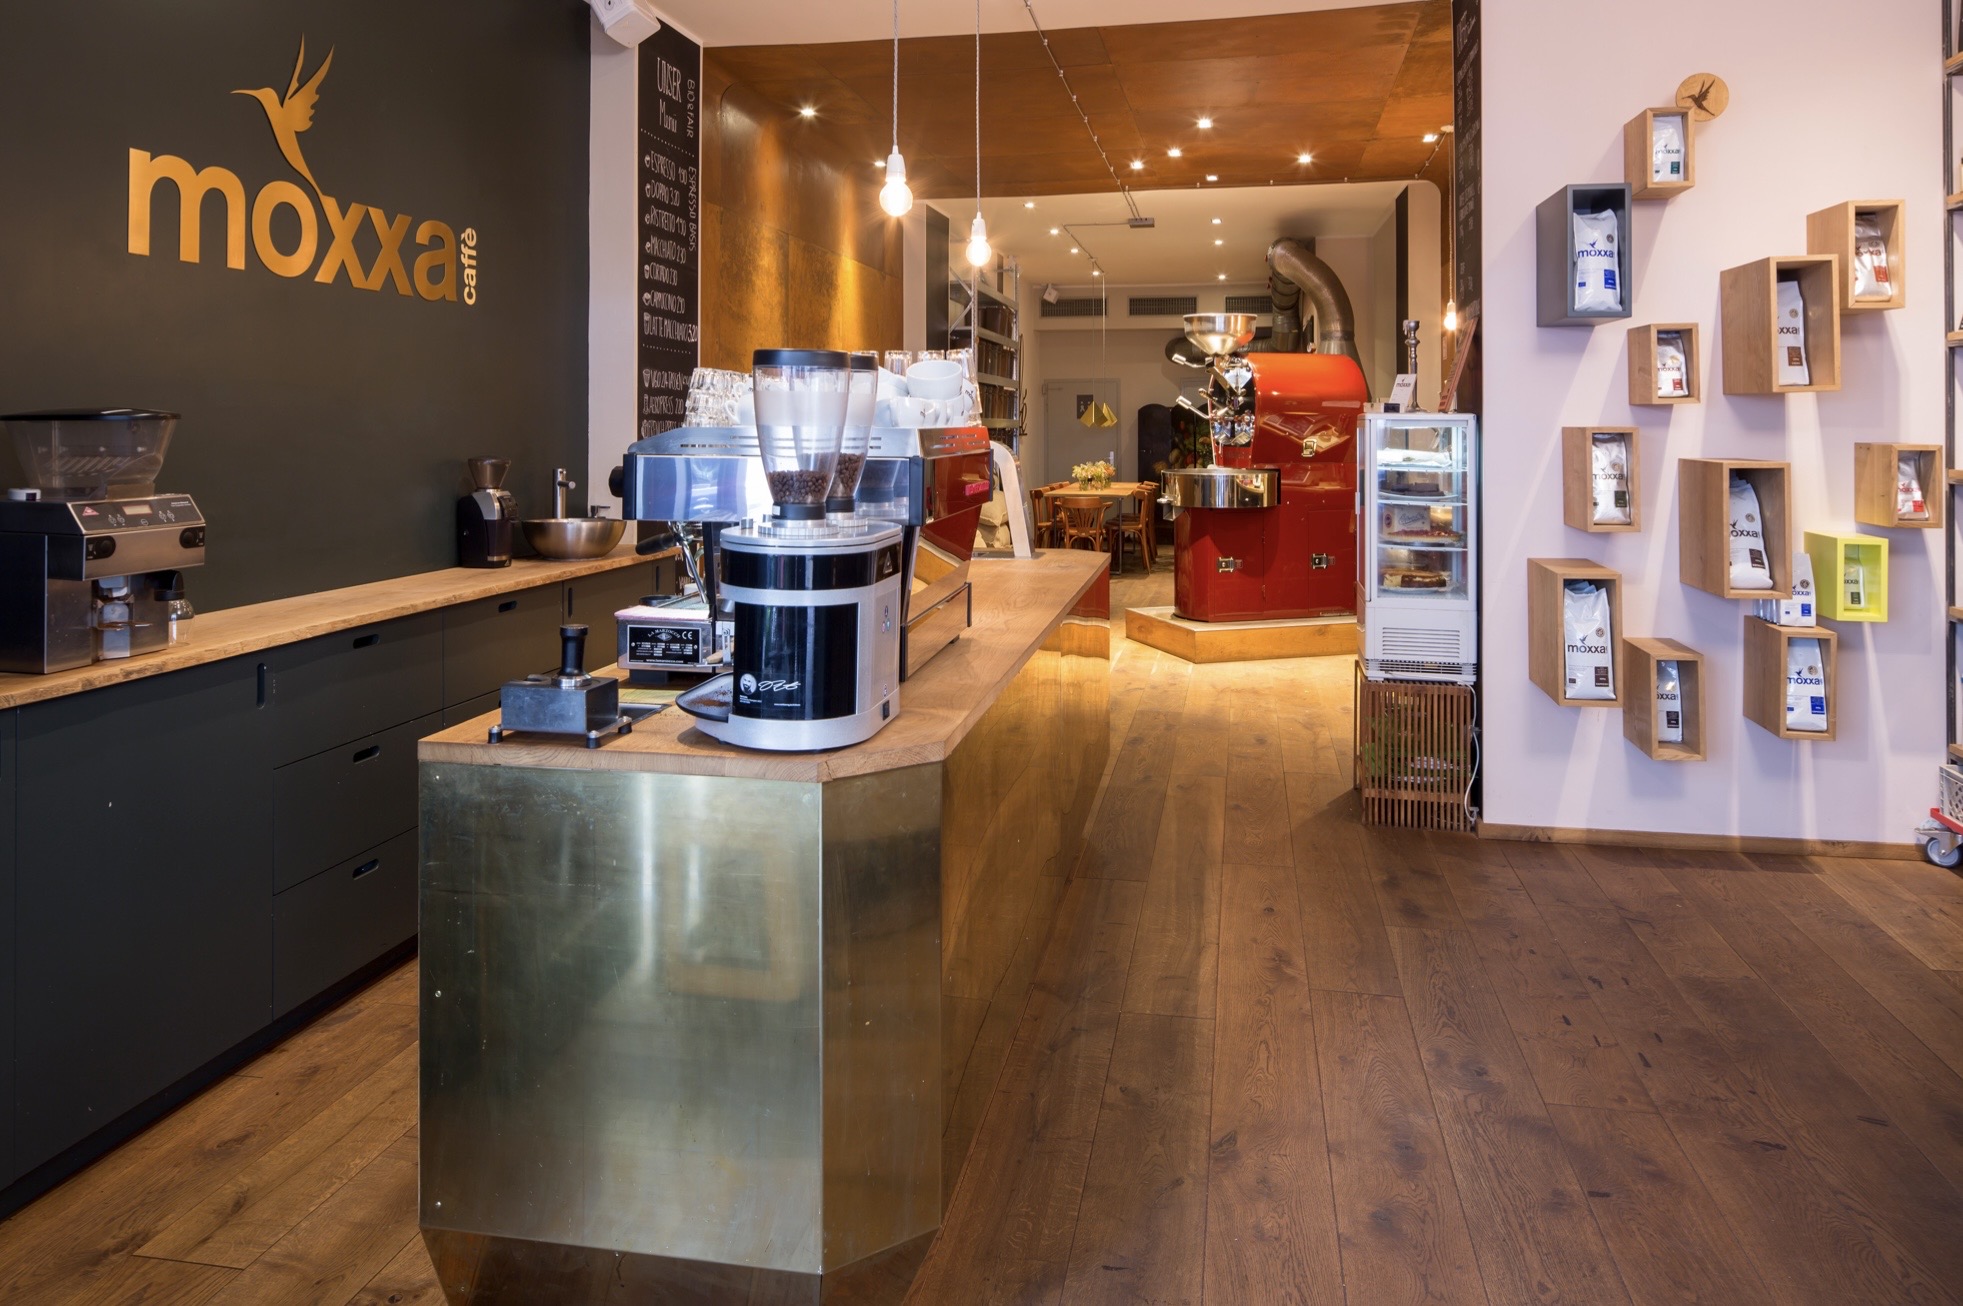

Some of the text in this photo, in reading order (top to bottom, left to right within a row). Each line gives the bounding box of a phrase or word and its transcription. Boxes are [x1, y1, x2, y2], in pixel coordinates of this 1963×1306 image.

[656, 57, 682, 103] UNSER
[651, 150, 676, 181] ESPRESSO
[651, 179, 669, 204] DOPPIO
[688, 166, 698, 219] ESPRESSO
[127, 147, 458, 302] moxxa
[650, 205, 676, 233] RISTRETTO
[650, 235, 676, 261] MACCHIATO
[1577, 249, 1615, 259] moxxa
[460, 227, 478, 306] caffè
[650, 262, 669, 284] CORTADO
[650, 290, 676, 313] CAPPUCCINO
[664, 317, 688, 342] MACCHIATO
[1567, 643, 1606, 654] moxxa
